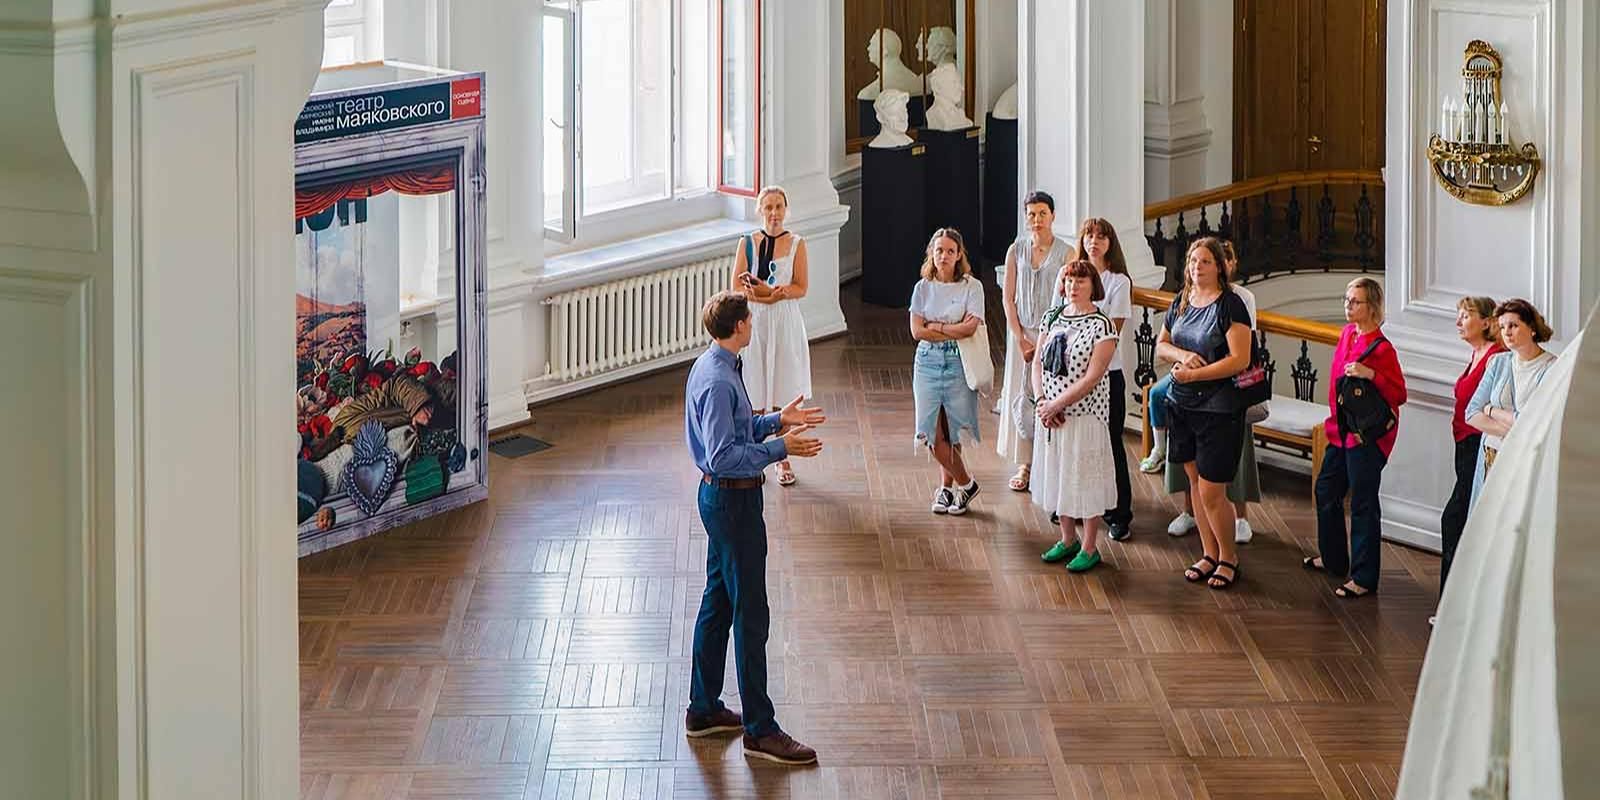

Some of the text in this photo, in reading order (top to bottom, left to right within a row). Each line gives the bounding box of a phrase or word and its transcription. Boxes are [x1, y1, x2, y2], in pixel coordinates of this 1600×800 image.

[336, 95, 385, 114] театр
[312, 117, 335, 126] имени
[336, 100, 445, 129] маяковского
[295, 124, 335, 135] владимира
